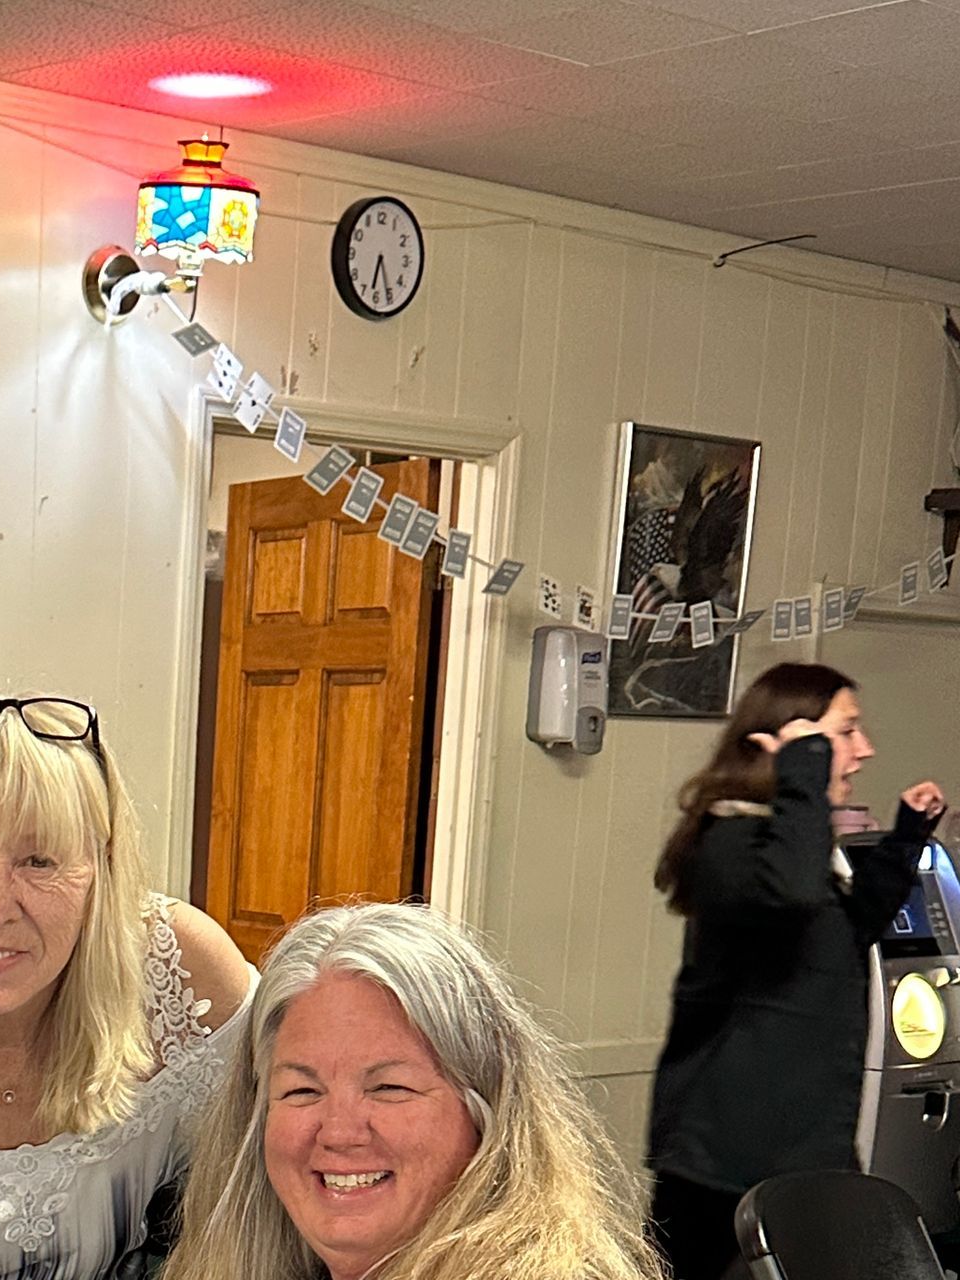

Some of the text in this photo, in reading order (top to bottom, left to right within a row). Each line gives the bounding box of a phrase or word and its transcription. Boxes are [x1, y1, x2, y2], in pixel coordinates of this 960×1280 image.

[377, 212, 387, 225] 12
[400, 234, 406, 247] 2
[402, 255, 409, 268] 3
[351, 268, 358, 281] 8
[396, 274, 403, 287] 4
[360, 284, 367, 296] 7
[386, 288, 393, 301] 5
[372, 291, 379, 304] 6
